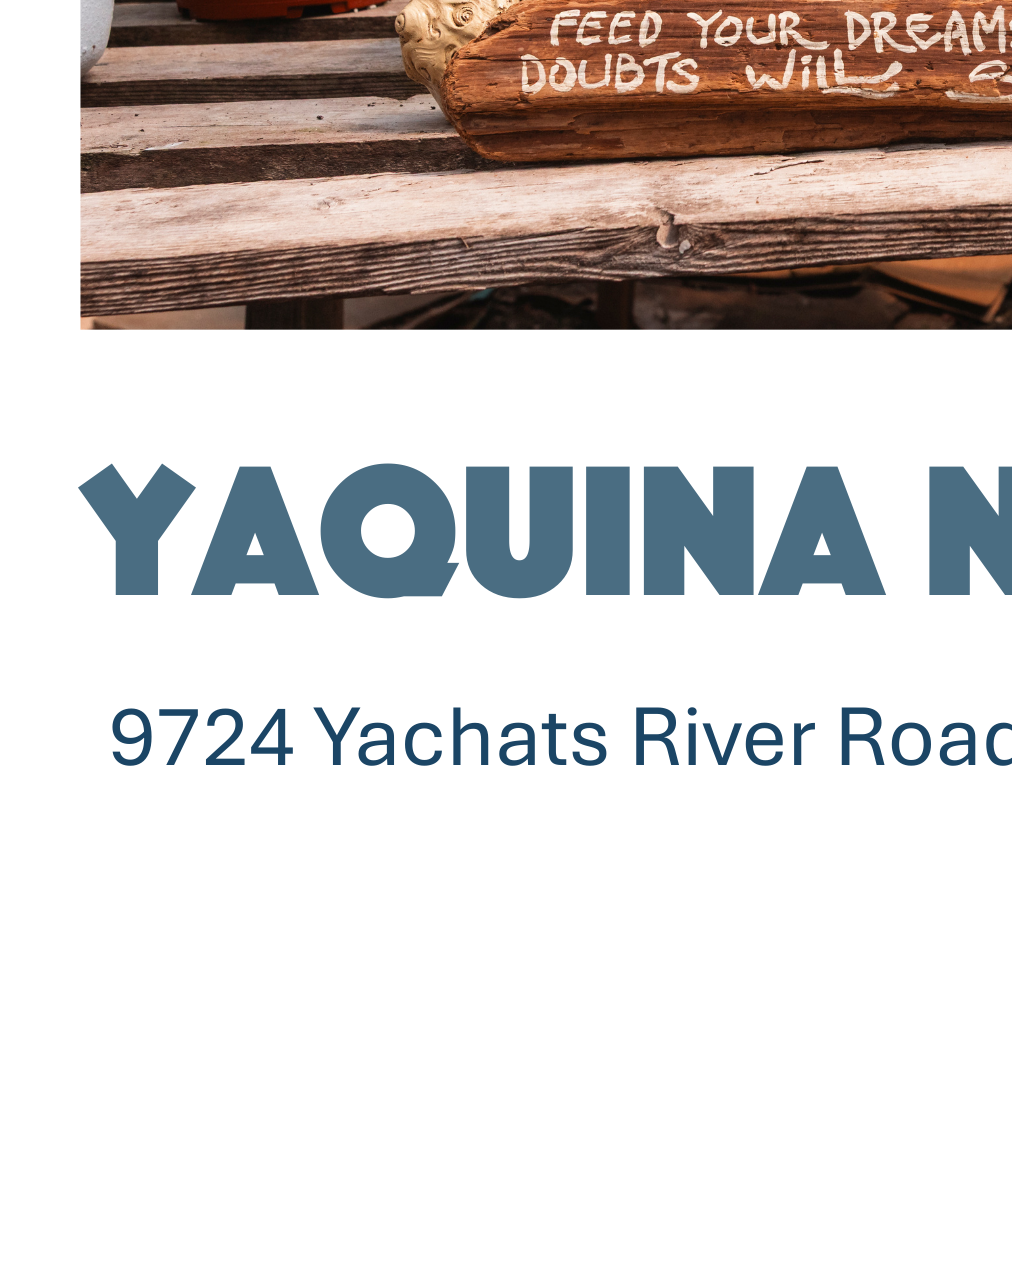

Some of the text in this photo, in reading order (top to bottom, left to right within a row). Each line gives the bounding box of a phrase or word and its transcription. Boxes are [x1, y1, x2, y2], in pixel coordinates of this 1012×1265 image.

[550, 9, 663, 49] FEED
[686, 9, 830, 51] YOUR
[520, 51, 700, 95] DOUBTS
